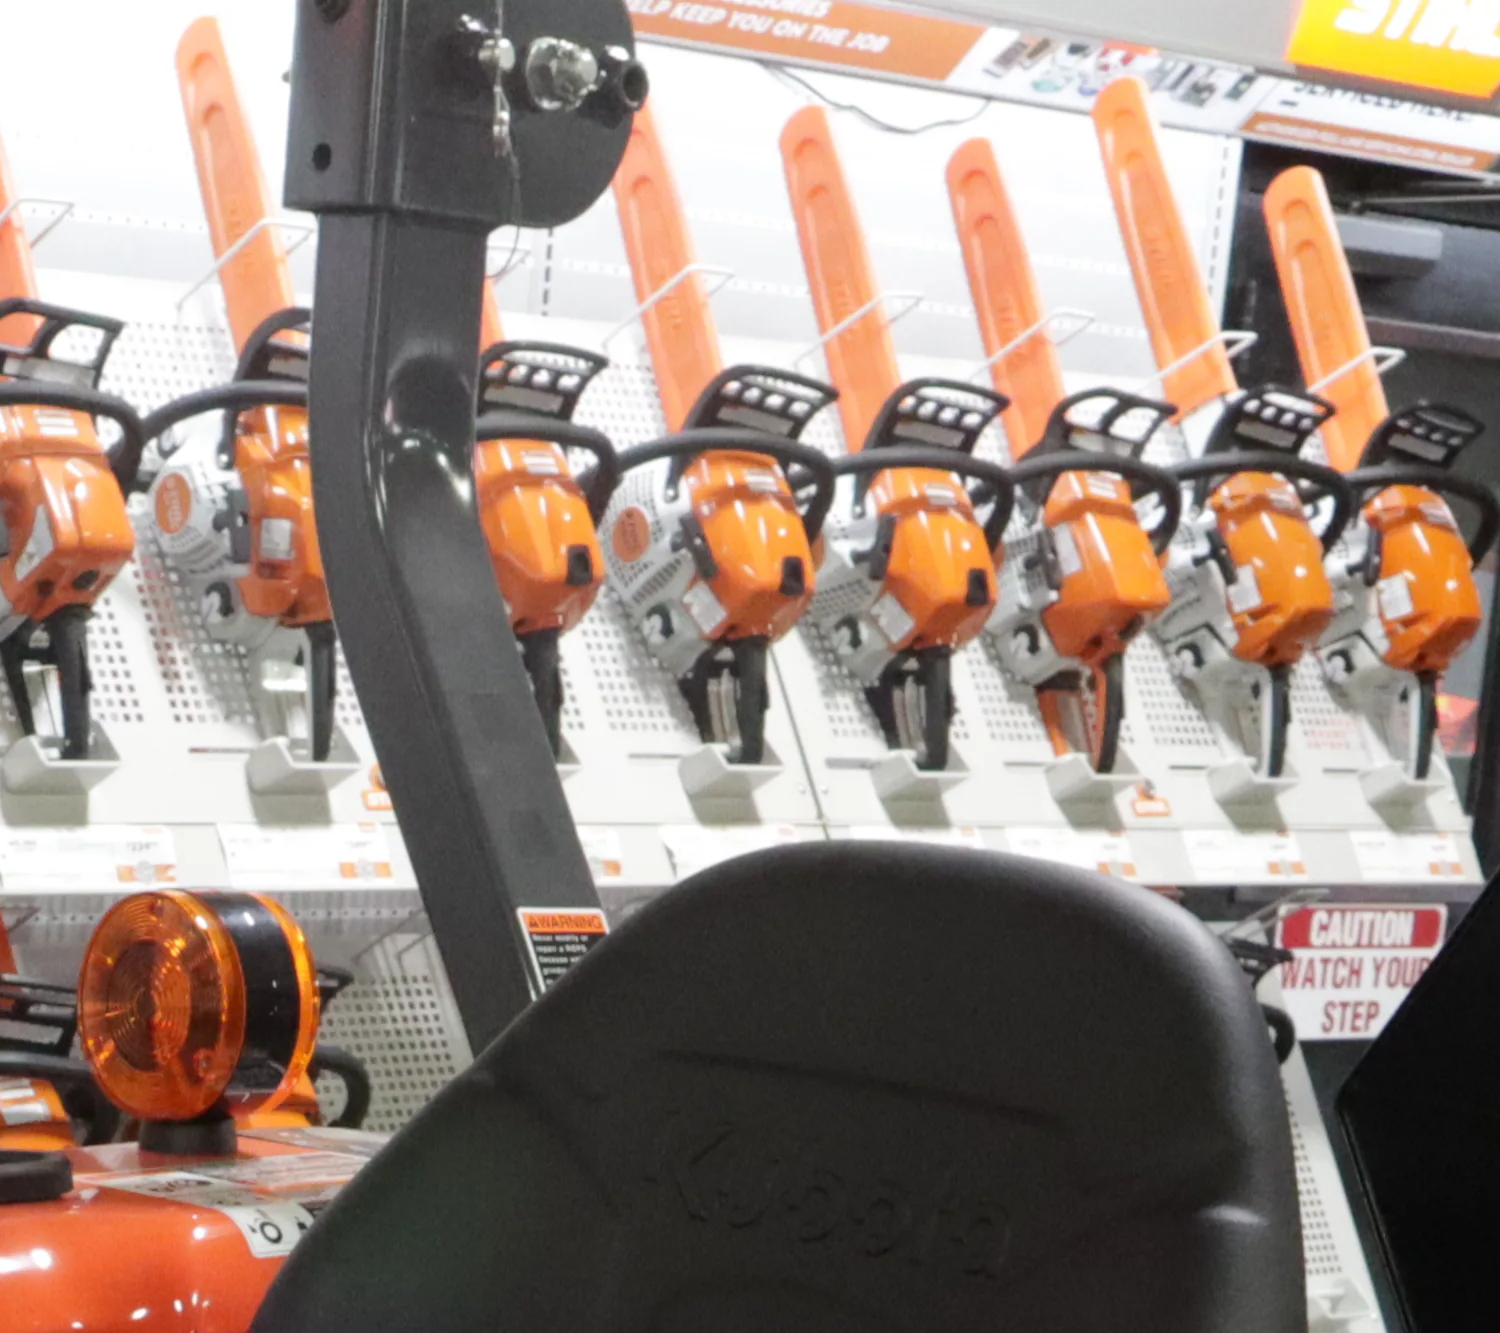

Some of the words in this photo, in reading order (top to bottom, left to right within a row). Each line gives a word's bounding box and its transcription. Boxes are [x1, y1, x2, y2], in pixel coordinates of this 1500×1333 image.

[669, 3, 728, 25] KEEP
[727, 13, 770, 34] YOU
[772, 19, 806, 39] ON
[807, 25, 849, 49] THE
[848, 32, 892, 53] JOB
[538, 914, 602, 929] WARNING
[1309, 911, 1414, 947] CAUTION
[1281, 957, 1362, 990] WATCH
[1321, 1000, 1380, 1034] STEP
[655, 1118, 1013, 1280] Kubota
